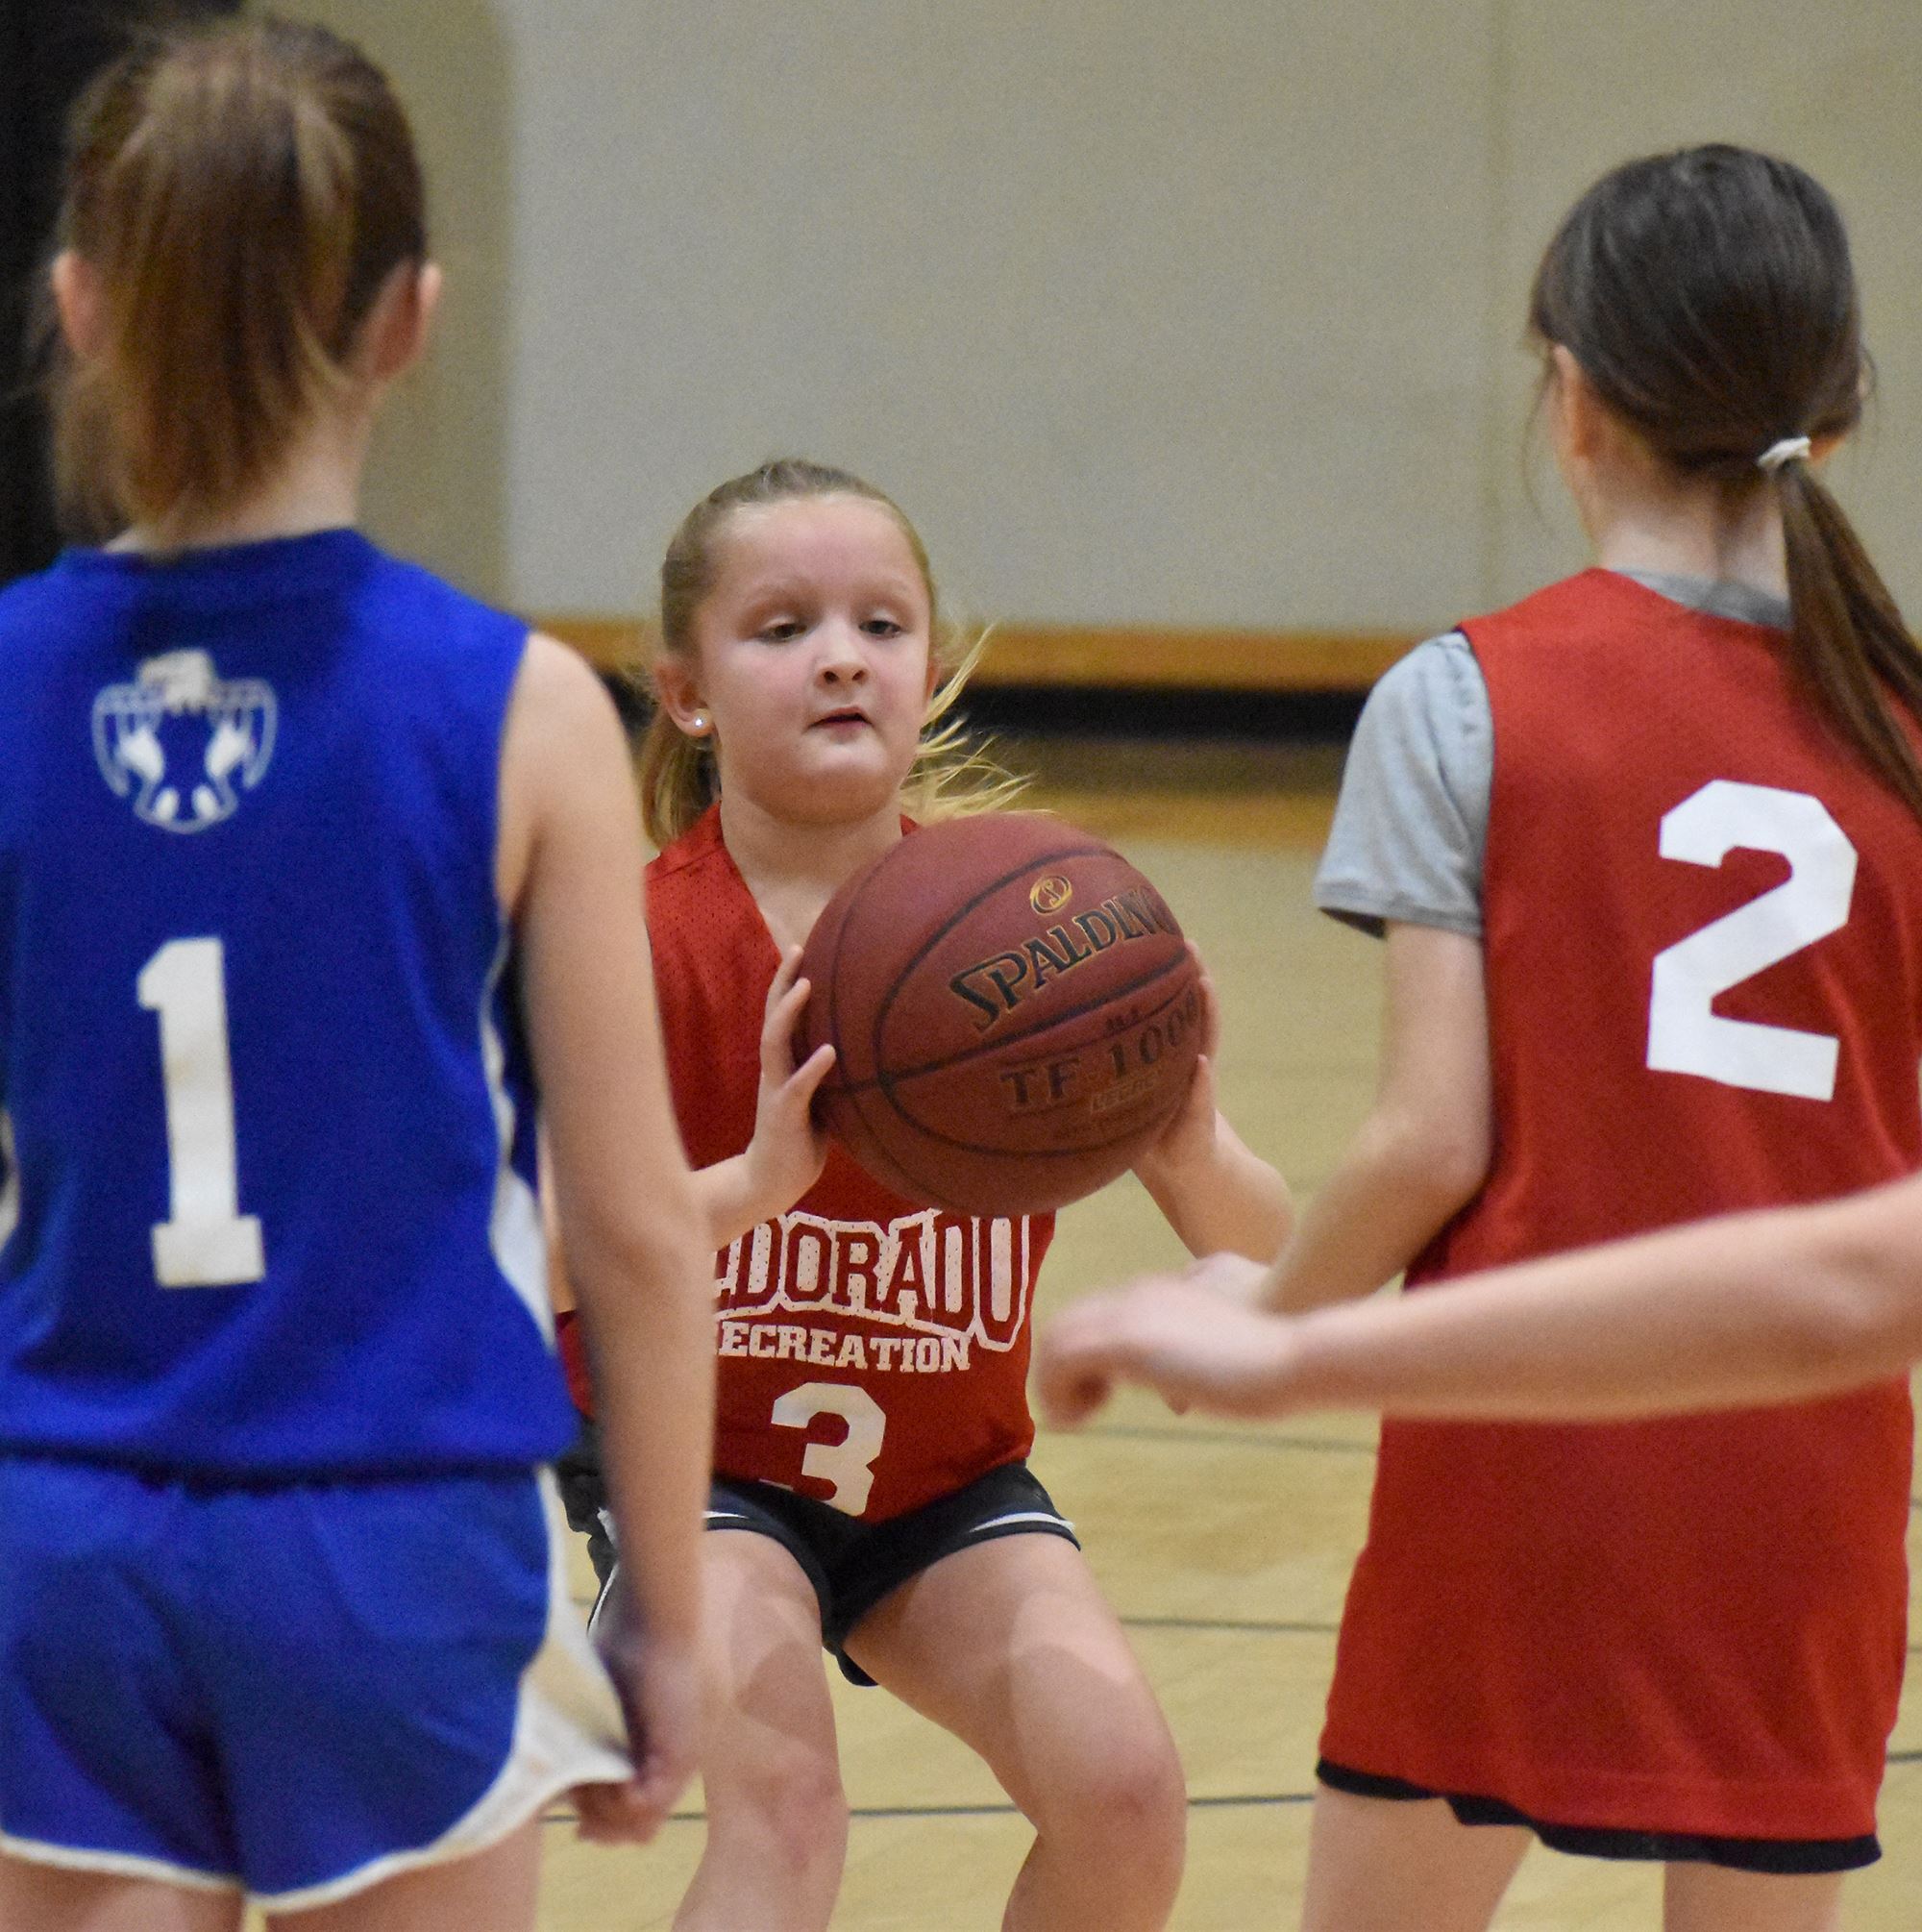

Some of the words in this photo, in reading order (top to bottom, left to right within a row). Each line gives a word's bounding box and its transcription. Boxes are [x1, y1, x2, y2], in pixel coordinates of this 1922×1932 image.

[1646, 779, 1859, 1102] 2
[136, 935, 265, 1288] 1
[715, 1207, 1030, 1352] DORADO
[716, 1320, 971, 1373] ECREATION
[769, 1381, 887, 1517] 3
